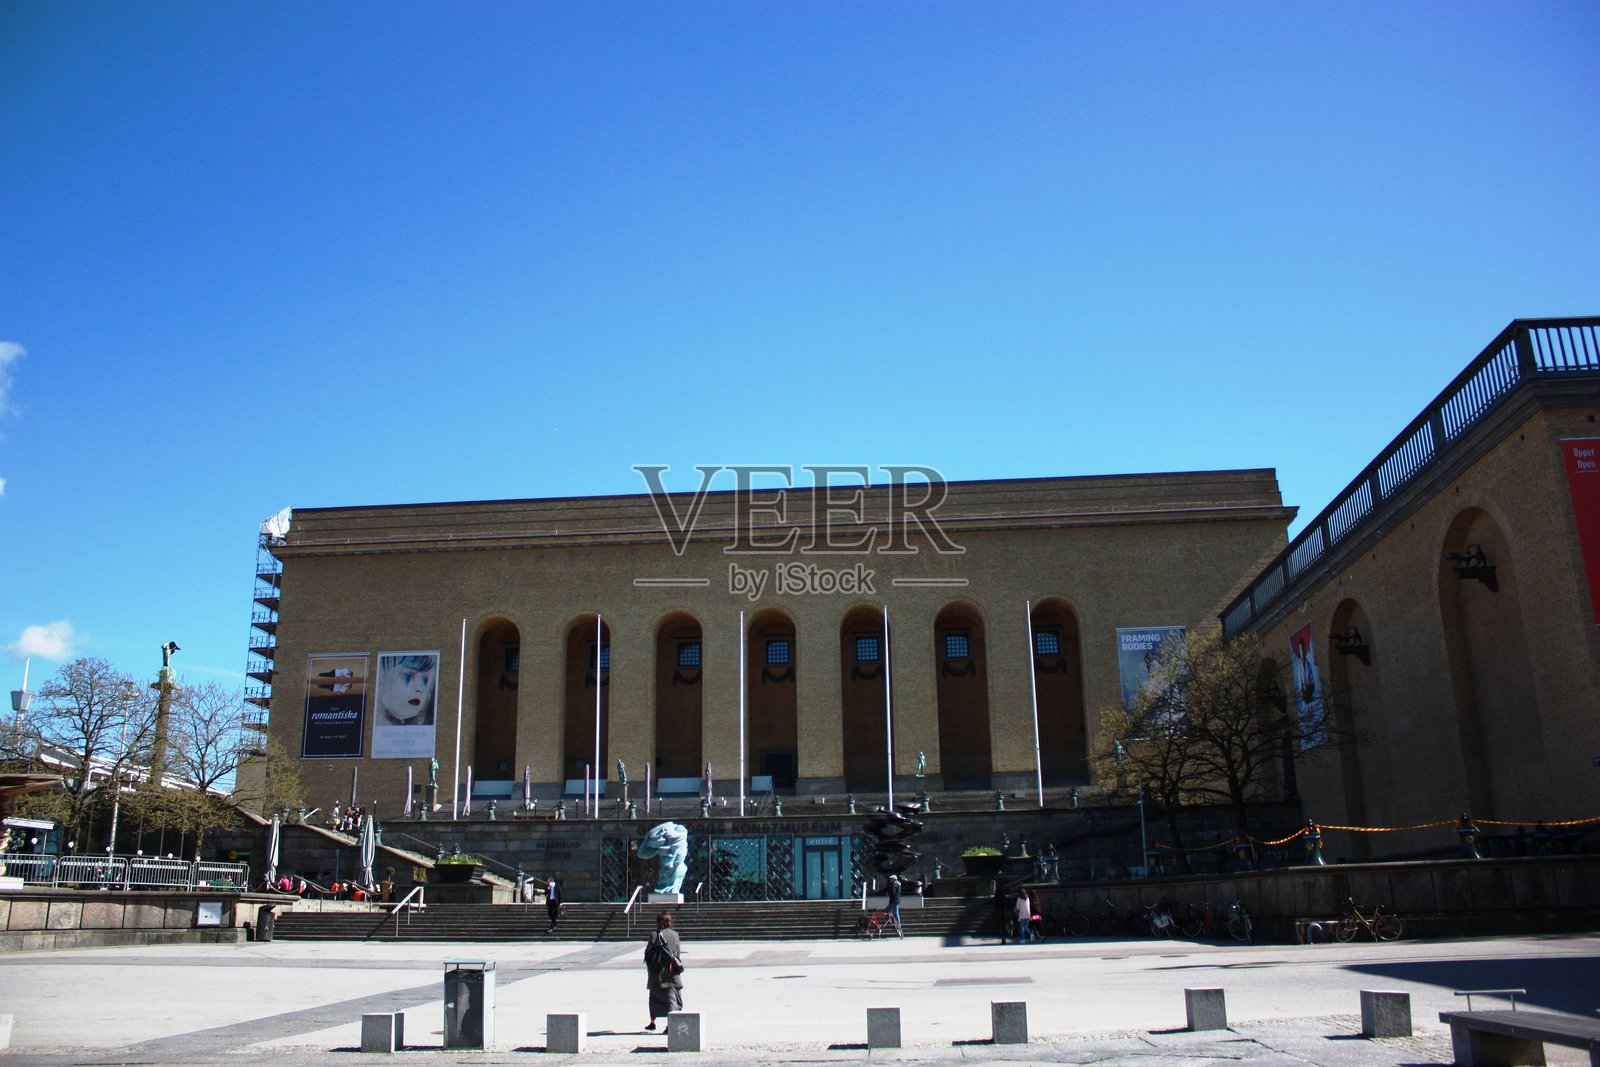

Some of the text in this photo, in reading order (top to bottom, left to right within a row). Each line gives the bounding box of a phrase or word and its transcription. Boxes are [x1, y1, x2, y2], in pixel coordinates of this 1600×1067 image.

[1578, 460, 1595, 469] Open
[1121, 633, 1160, 642] FRAMING
[1121, 642, 1153, 651] BODIES
[312, 710, 357, 719] romantiska
[732, 820, 842, 834] KONSTMUSEUM
